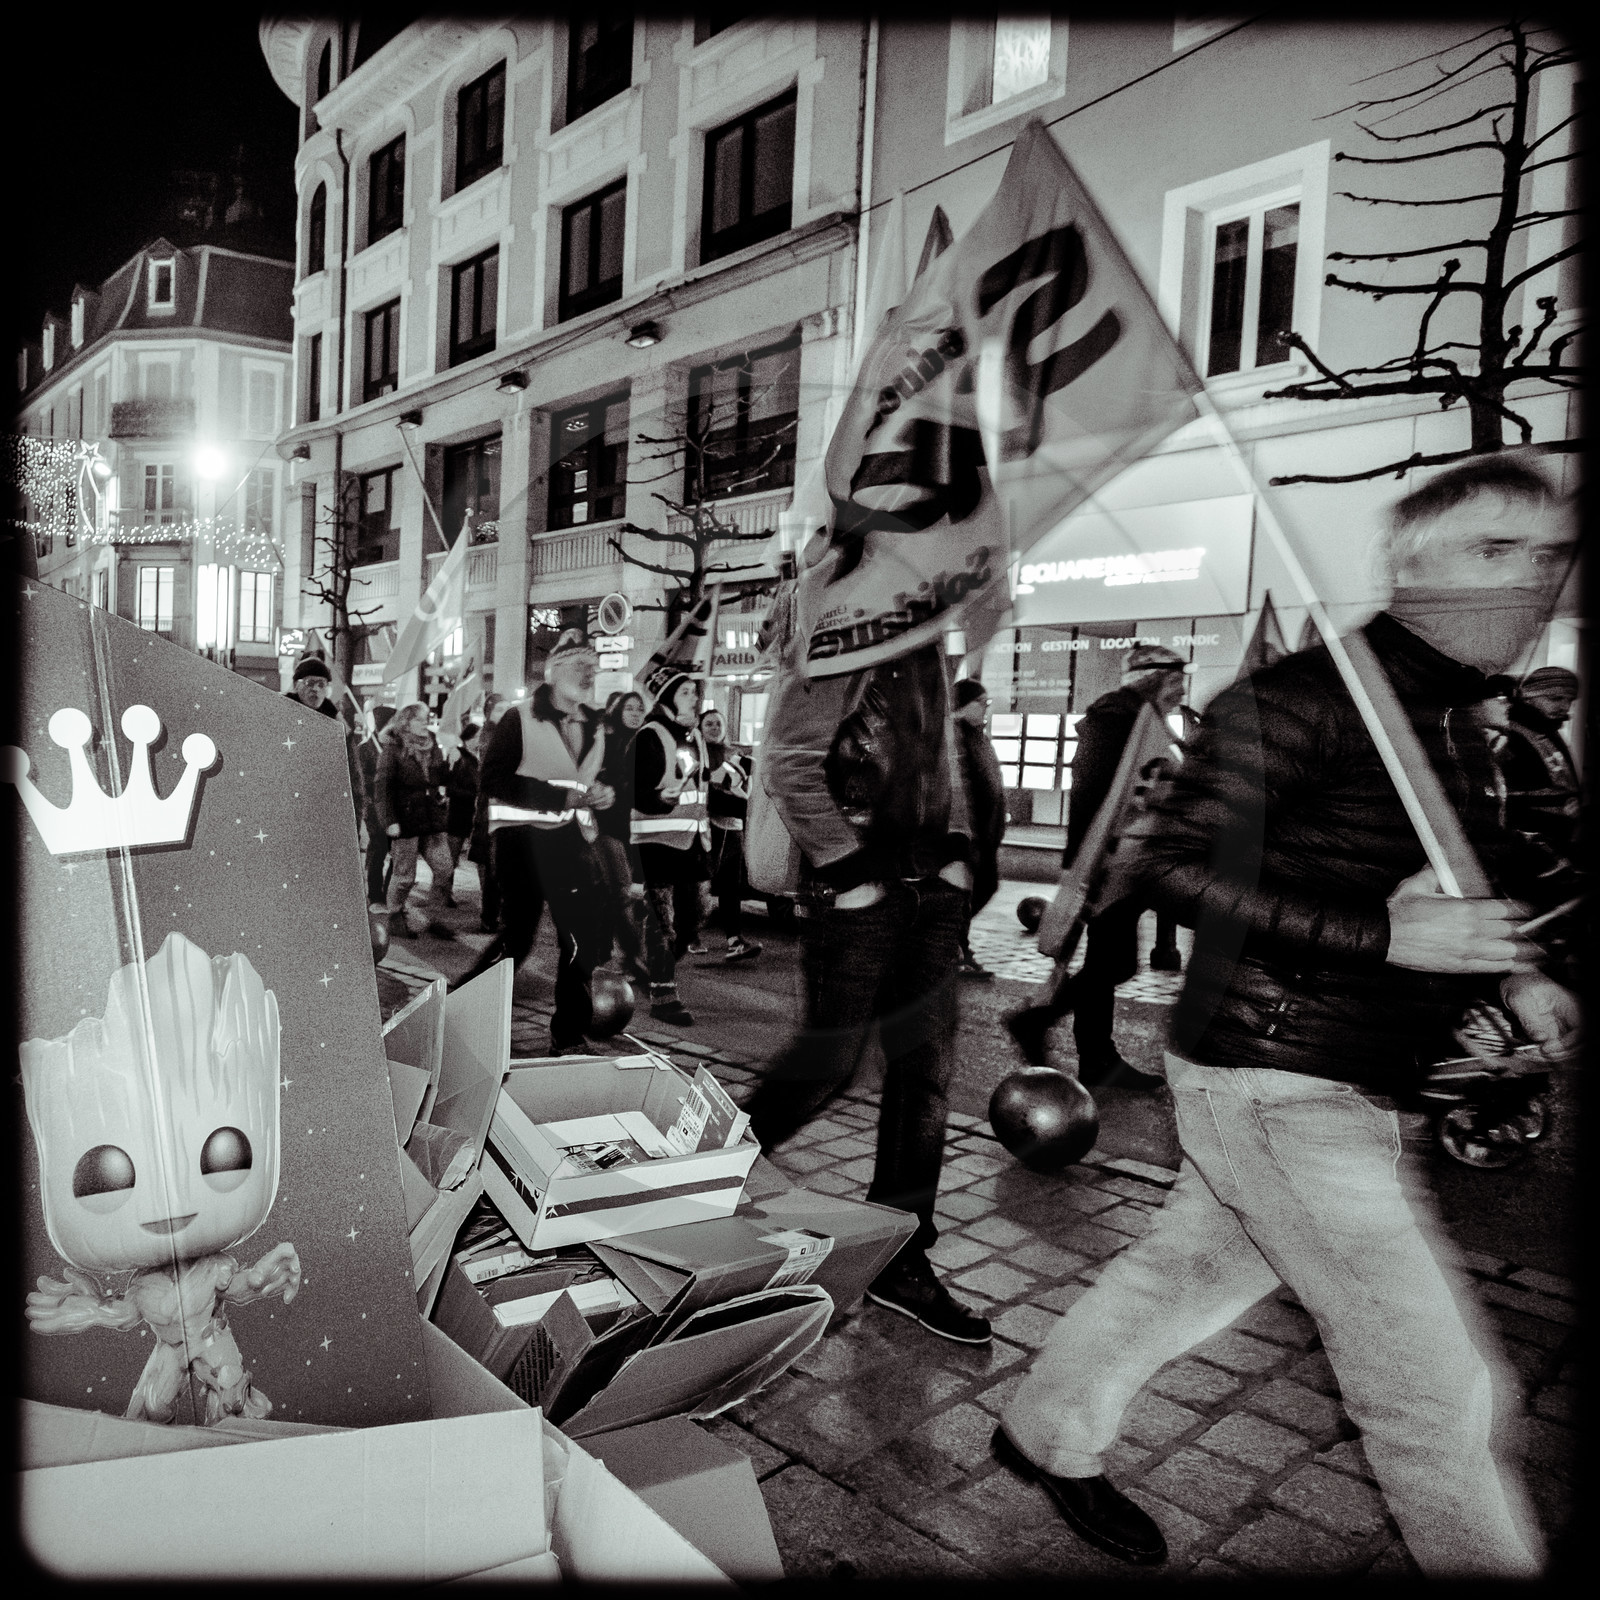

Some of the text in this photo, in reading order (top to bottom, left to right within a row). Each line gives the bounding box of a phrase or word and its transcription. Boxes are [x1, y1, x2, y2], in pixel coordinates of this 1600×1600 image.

[1041, 639, 1090, 652] GESTION
[1100, 636, 1161, 649] LOCATON
[1172, 634, 1220, 647] SYNDIC
